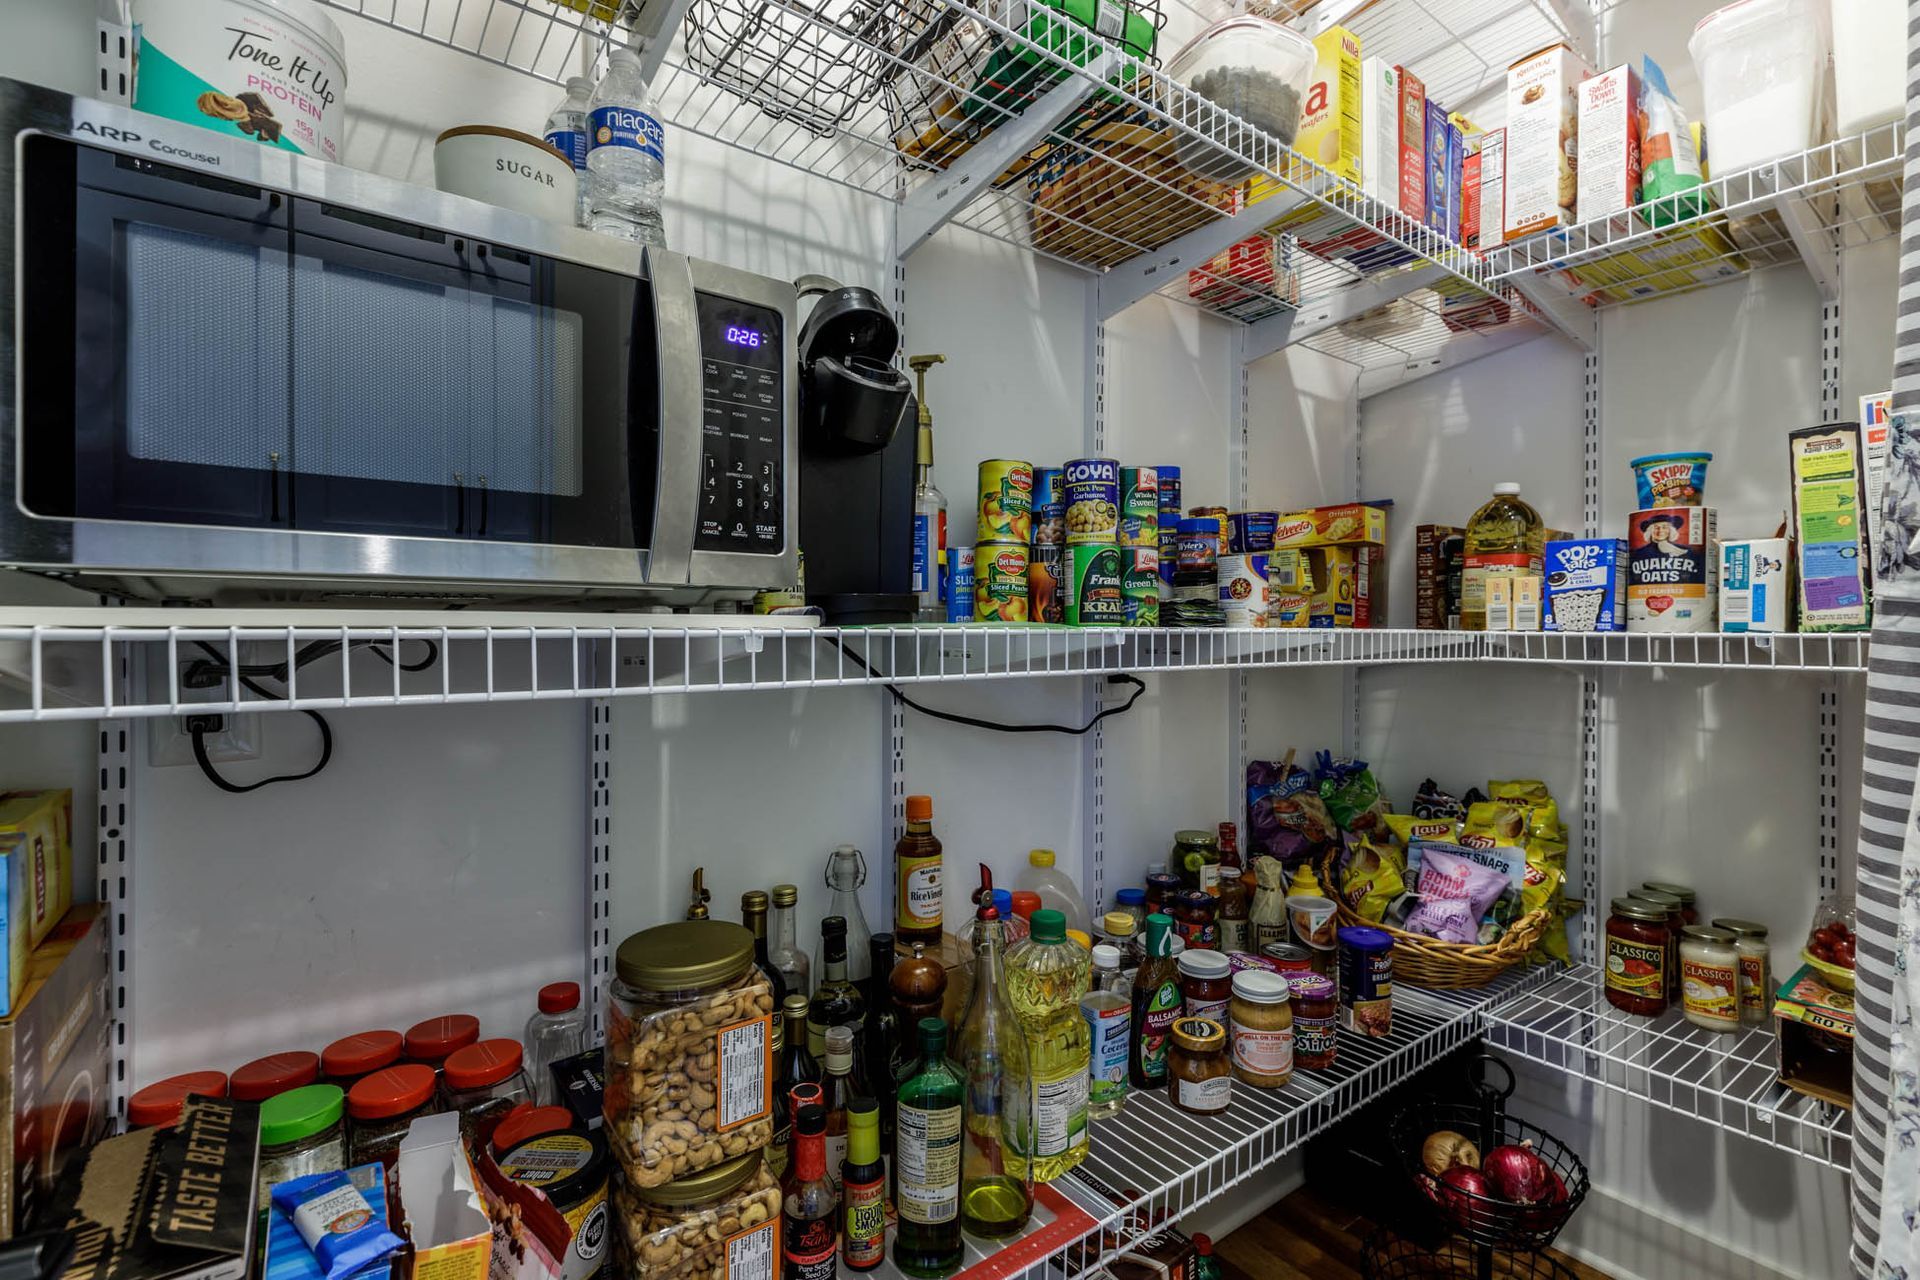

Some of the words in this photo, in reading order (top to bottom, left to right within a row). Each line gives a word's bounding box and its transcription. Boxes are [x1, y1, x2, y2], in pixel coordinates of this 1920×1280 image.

[1342, 36, 1359, 57] Nilla
[225, 26, 283, 71] Tone
[289, 56, 312, 83] It
[312, 71, 334, 110] Up
[248, 75, 322, 121] PROTEIN
[1301, 112, 1329, 130] wafers
[607, 110, 664, 145] niagara
[149, 139, 220, 166] Carousel
[496, 158, 555, 188] SUGAR
[727, 327, 759, 347] 0:26
[709, 459, 714, 468] 1
[736, 462, 743, 471] 2
[763, 465, 769, 474] 3
[1066, 464, 1114, 481] GOYA
[1651, 464, 1692, 484] SKIPPY
[708, 477, 715, 486] 4
[737, 480, 743, 489] 5
[763, 483, 769, 492] 6
[1073, 484, 1092, 492] Chick
[1093, 484, 1105, 492] Peas
[709, 495, 715, 504] 7
[1073, 492, 1106, 500] Garbanzos
[736, 498, 743, 507] 8
[763, 500, 769, 509] 9
[1129, 499, 1153, 507] Sweet
[1328, 509, 1359, 519] Original
[1632, 558, 1695, 574] QUAKER
[1754, 553, 1763, 578] QUAKER
[955, 575, 974, 585] SLIC
[1089, 574, 1120, 585] Frank
[1641, 571, 1680, 583] OATS
[1124, 580, 1151, 589] Green
[1545, 614, 1553, 624] 8
[1413, 824, 1447, 837] Lay's
[1473, 852, 1510, 874] SNAPS
[910, 890, 927, 902] Rice
[1610, 942, 1661, 962] CLASSICO
[1684, 965, 1733, 981] CLASSICO
[1148, 1006, 1182, 1023] BALSAMIC
[184, 1102, 234, 1166] BETTER
[915, 1130, 926, 1138] 120
[169, 1167, 219, 1232] TASTE
[798, 1264, 814, 1272] Pure
[805, 1271, 821, 1279] Seed
